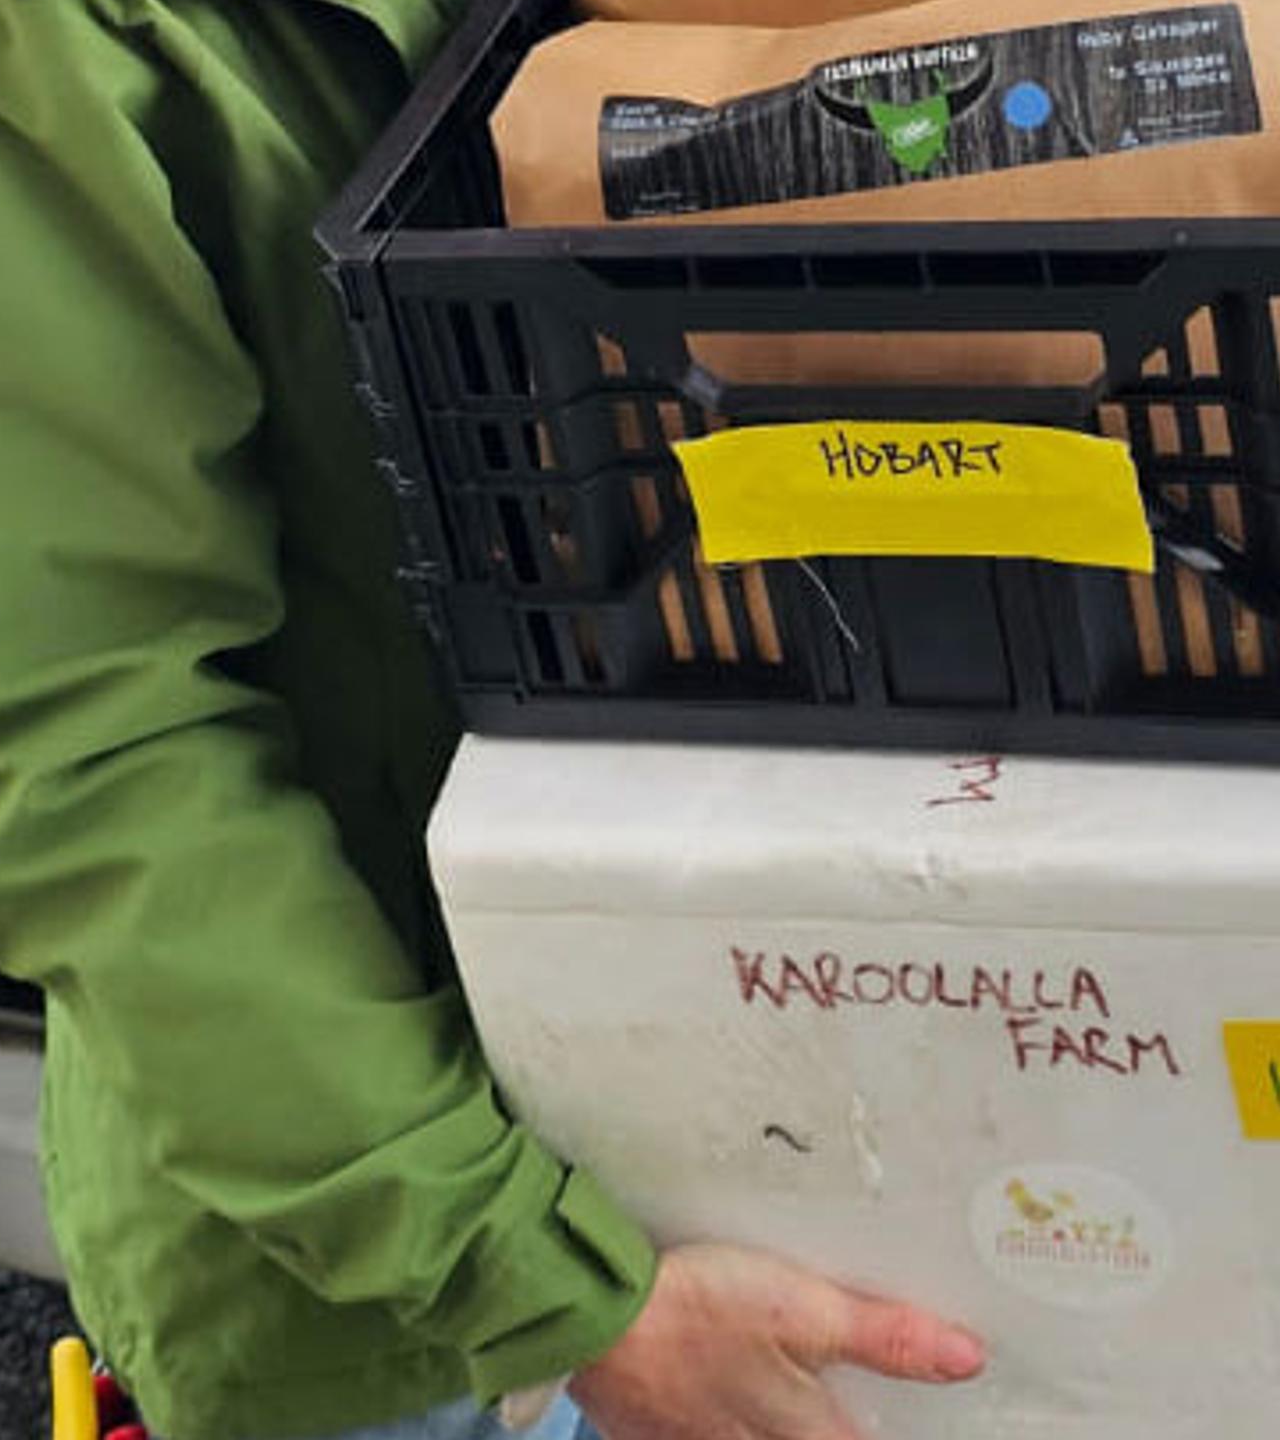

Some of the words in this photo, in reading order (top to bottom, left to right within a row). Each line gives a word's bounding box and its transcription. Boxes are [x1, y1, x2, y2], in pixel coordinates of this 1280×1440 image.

[820, 430, 1003, 479] HOBART
[731, 946, 1111, 1019] KAROOLALLA
[1006, 1016, 1180, 1076] FARM
